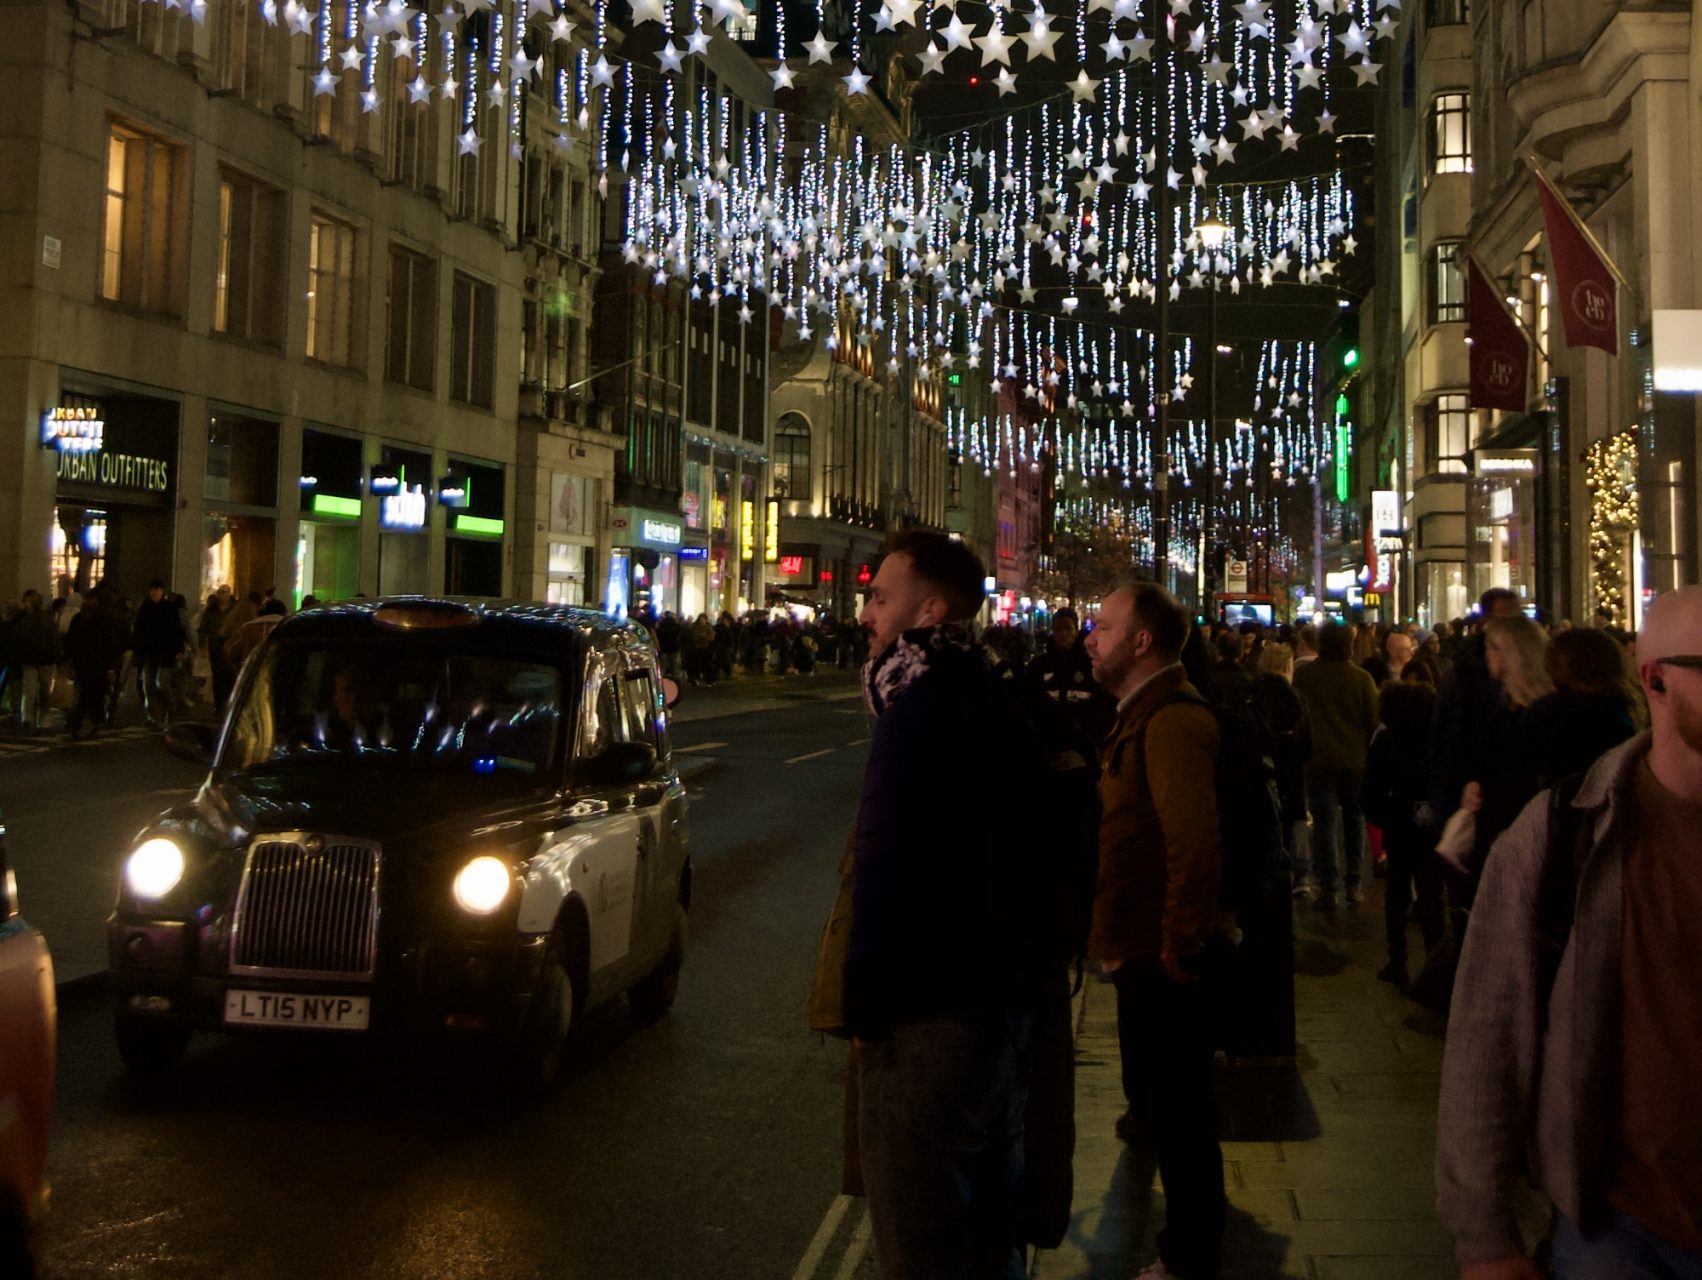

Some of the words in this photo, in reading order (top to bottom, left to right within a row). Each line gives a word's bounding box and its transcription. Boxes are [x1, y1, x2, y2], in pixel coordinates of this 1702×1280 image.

[101, 452, 168, 490] OUTFITTERS
[239, 993, 296, 1019] LT15
[302, 997, 353, 1022] NYP
